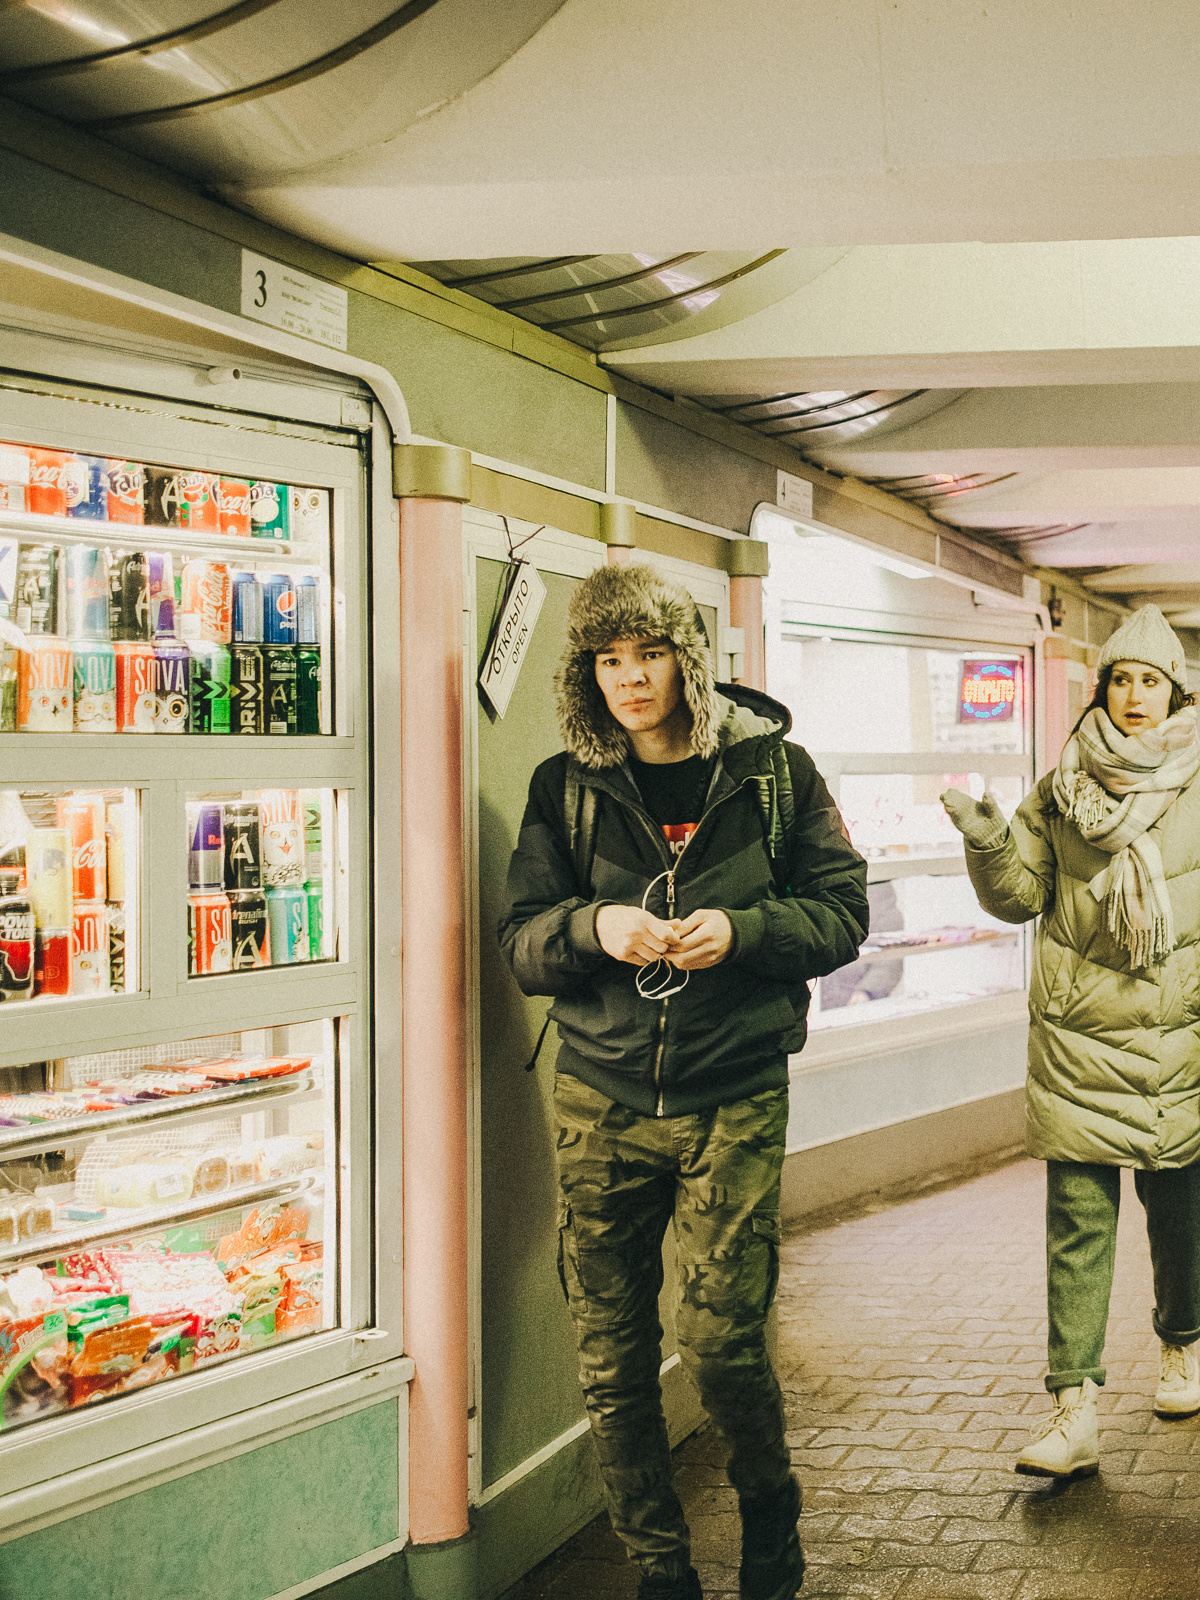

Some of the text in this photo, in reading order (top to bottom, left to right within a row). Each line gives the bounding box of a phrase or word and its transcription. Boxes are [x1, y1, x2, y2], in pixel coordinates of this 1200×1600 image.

[254, 270, 268, 308] 3
[493, 580, 528, 675] ОТКРЫТО
[512, 623, 528, 664] OPEN
